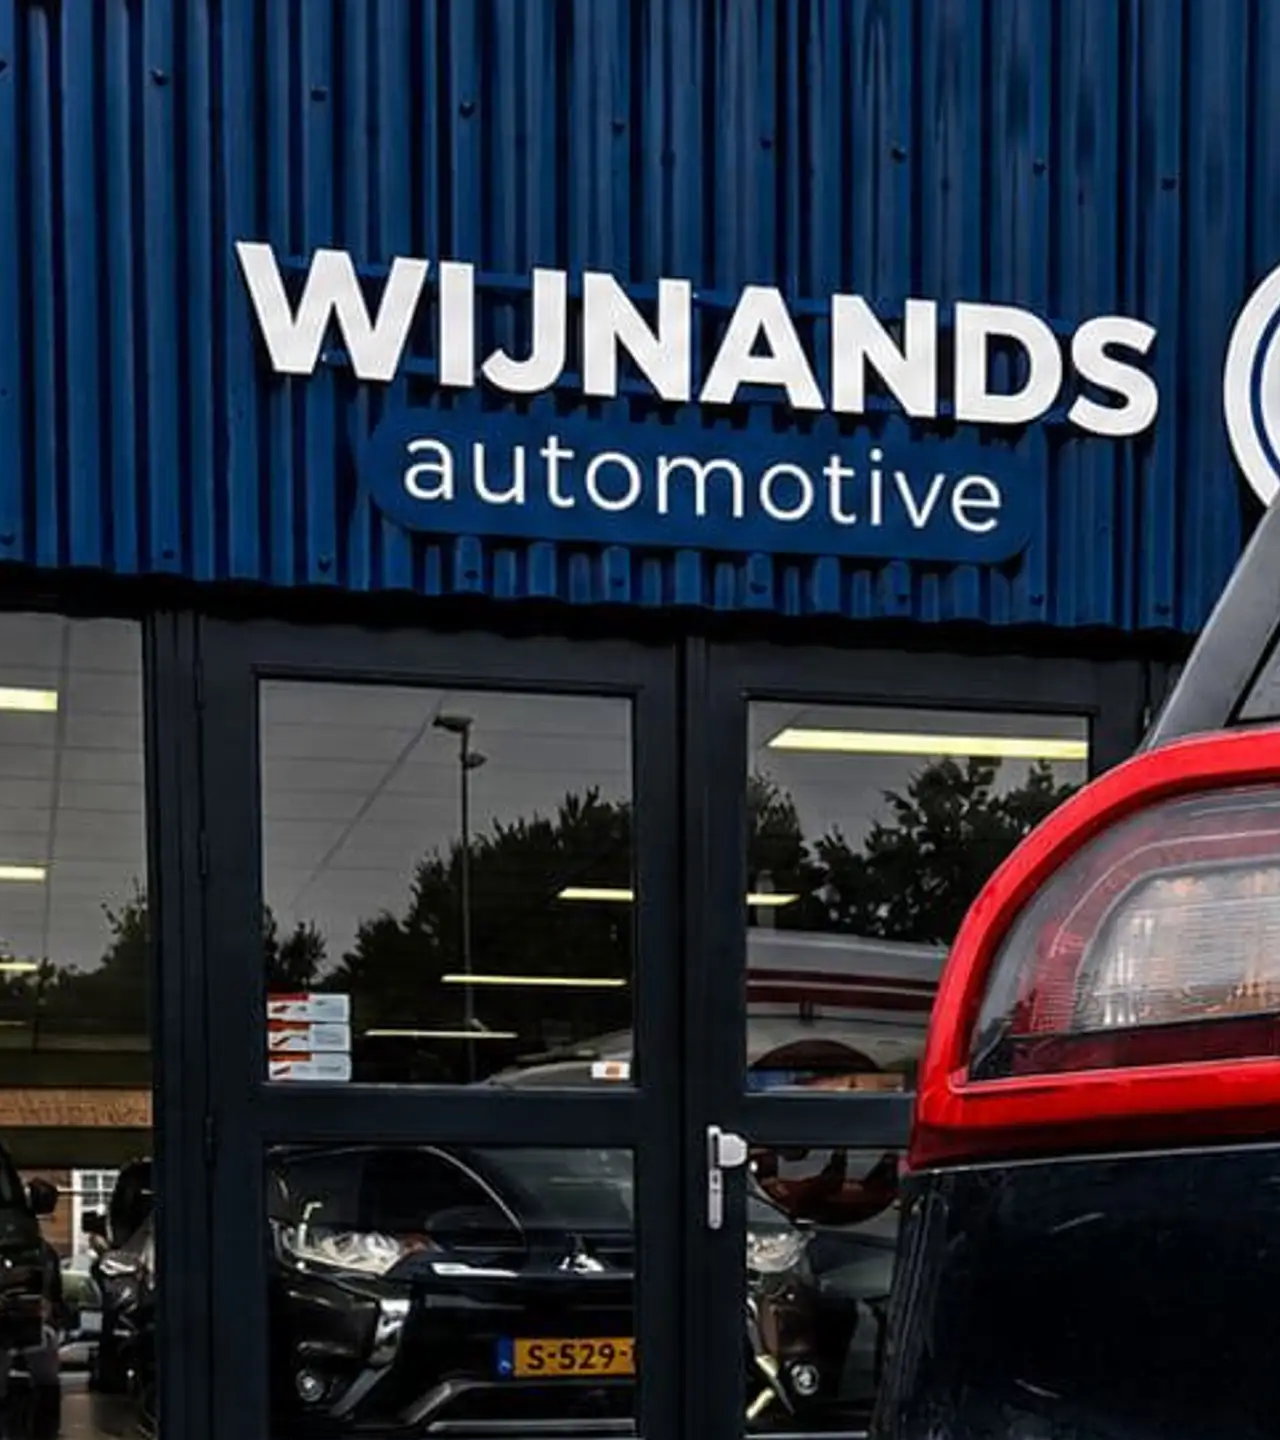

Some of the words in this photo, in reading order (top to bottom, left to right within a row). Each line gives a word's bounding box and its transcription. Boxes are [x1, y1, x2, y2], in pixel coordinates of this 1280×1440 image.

[237, 241, 1158, 435] WIJNANDS
[404, 438, 1005, 533] automotive
[526, 1343, 636, 1371] S-529-
